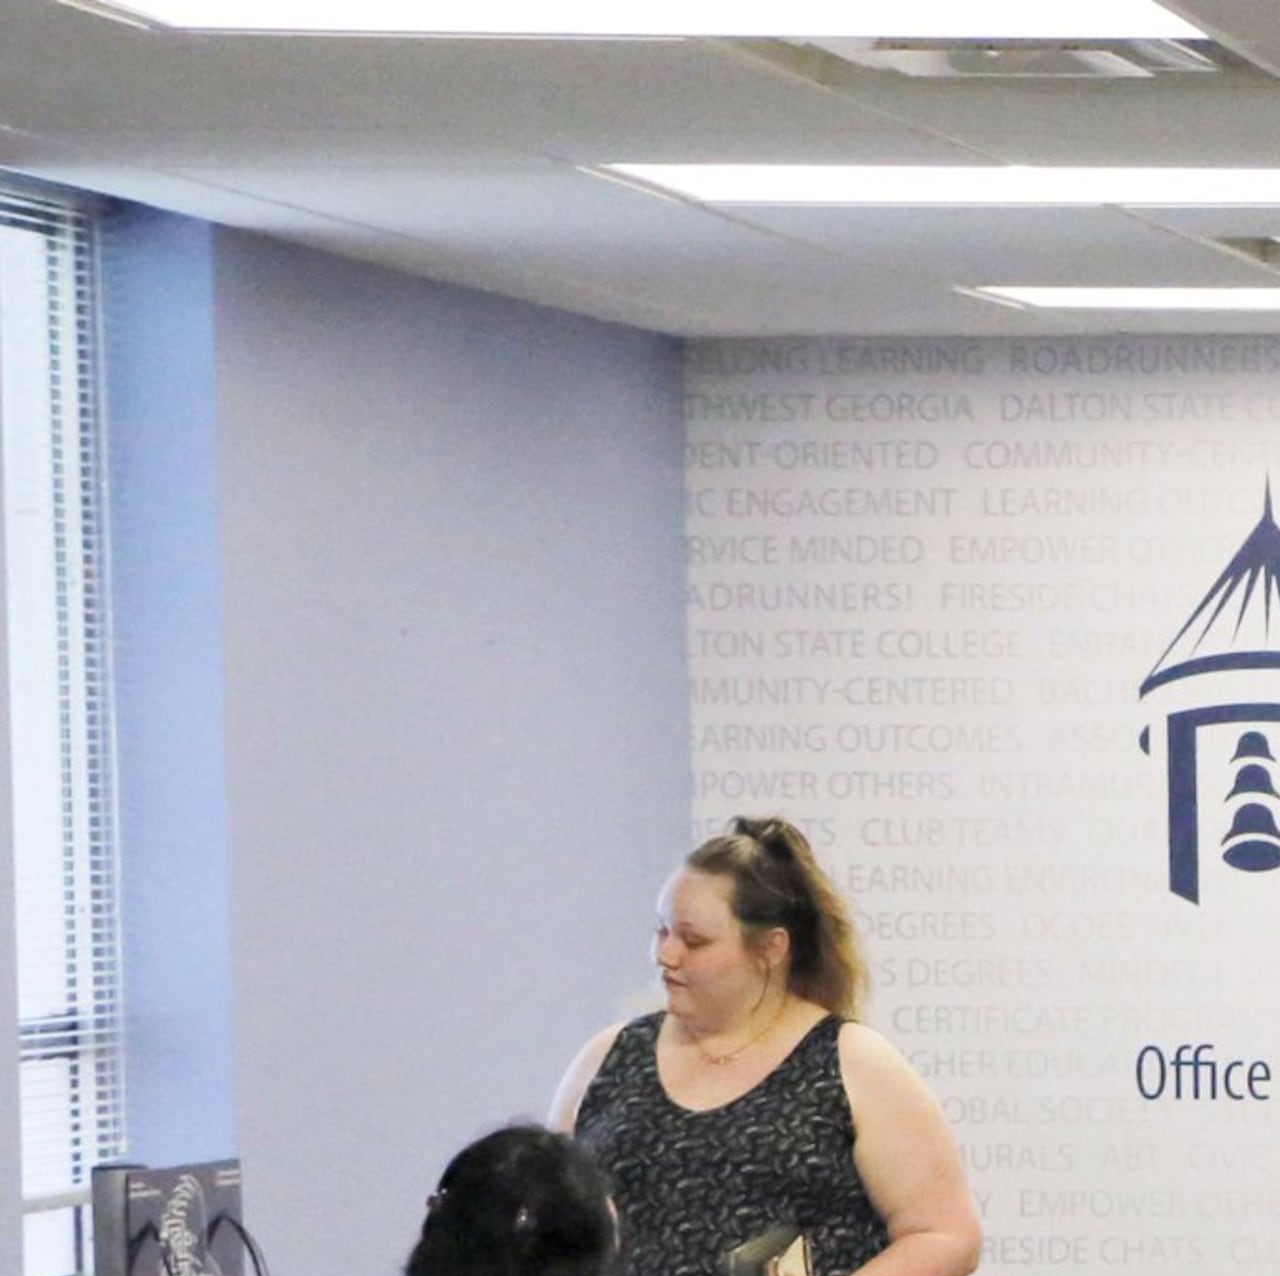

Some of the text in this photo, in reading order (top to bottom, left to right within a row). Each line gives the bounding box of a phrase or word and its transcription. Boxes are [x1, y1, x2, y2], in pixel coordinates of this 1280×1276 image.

[825, 392, 973, 422] GEORGIA
[1000, 391, 1132, 421] DALTON
[1143, 391, 1234, 420] STATE
[727, 487, 959, 517] ENGAGEMENT
[982, 486, 1148, 516] LEARNING
[789, 535, 924, 564] MINDED
[949, 534, 1119, 564] EMPOWER
[775, 629, 866, 659] STATE
[877, 629, 1022, 658] COLLEGE
[837, 723, 1022, 753] OUTCOMES
[828, 770, 955, 800] OTHERS
[861, 818, 944, 847] CLUB
[847, 865, 995, 894] EARNING
[1135, 1045, 1271, 1102] Office
[1019, 1190, 1188, 1219] EMPOWER
[1100, 1237, 1204, 1266] CHATS
